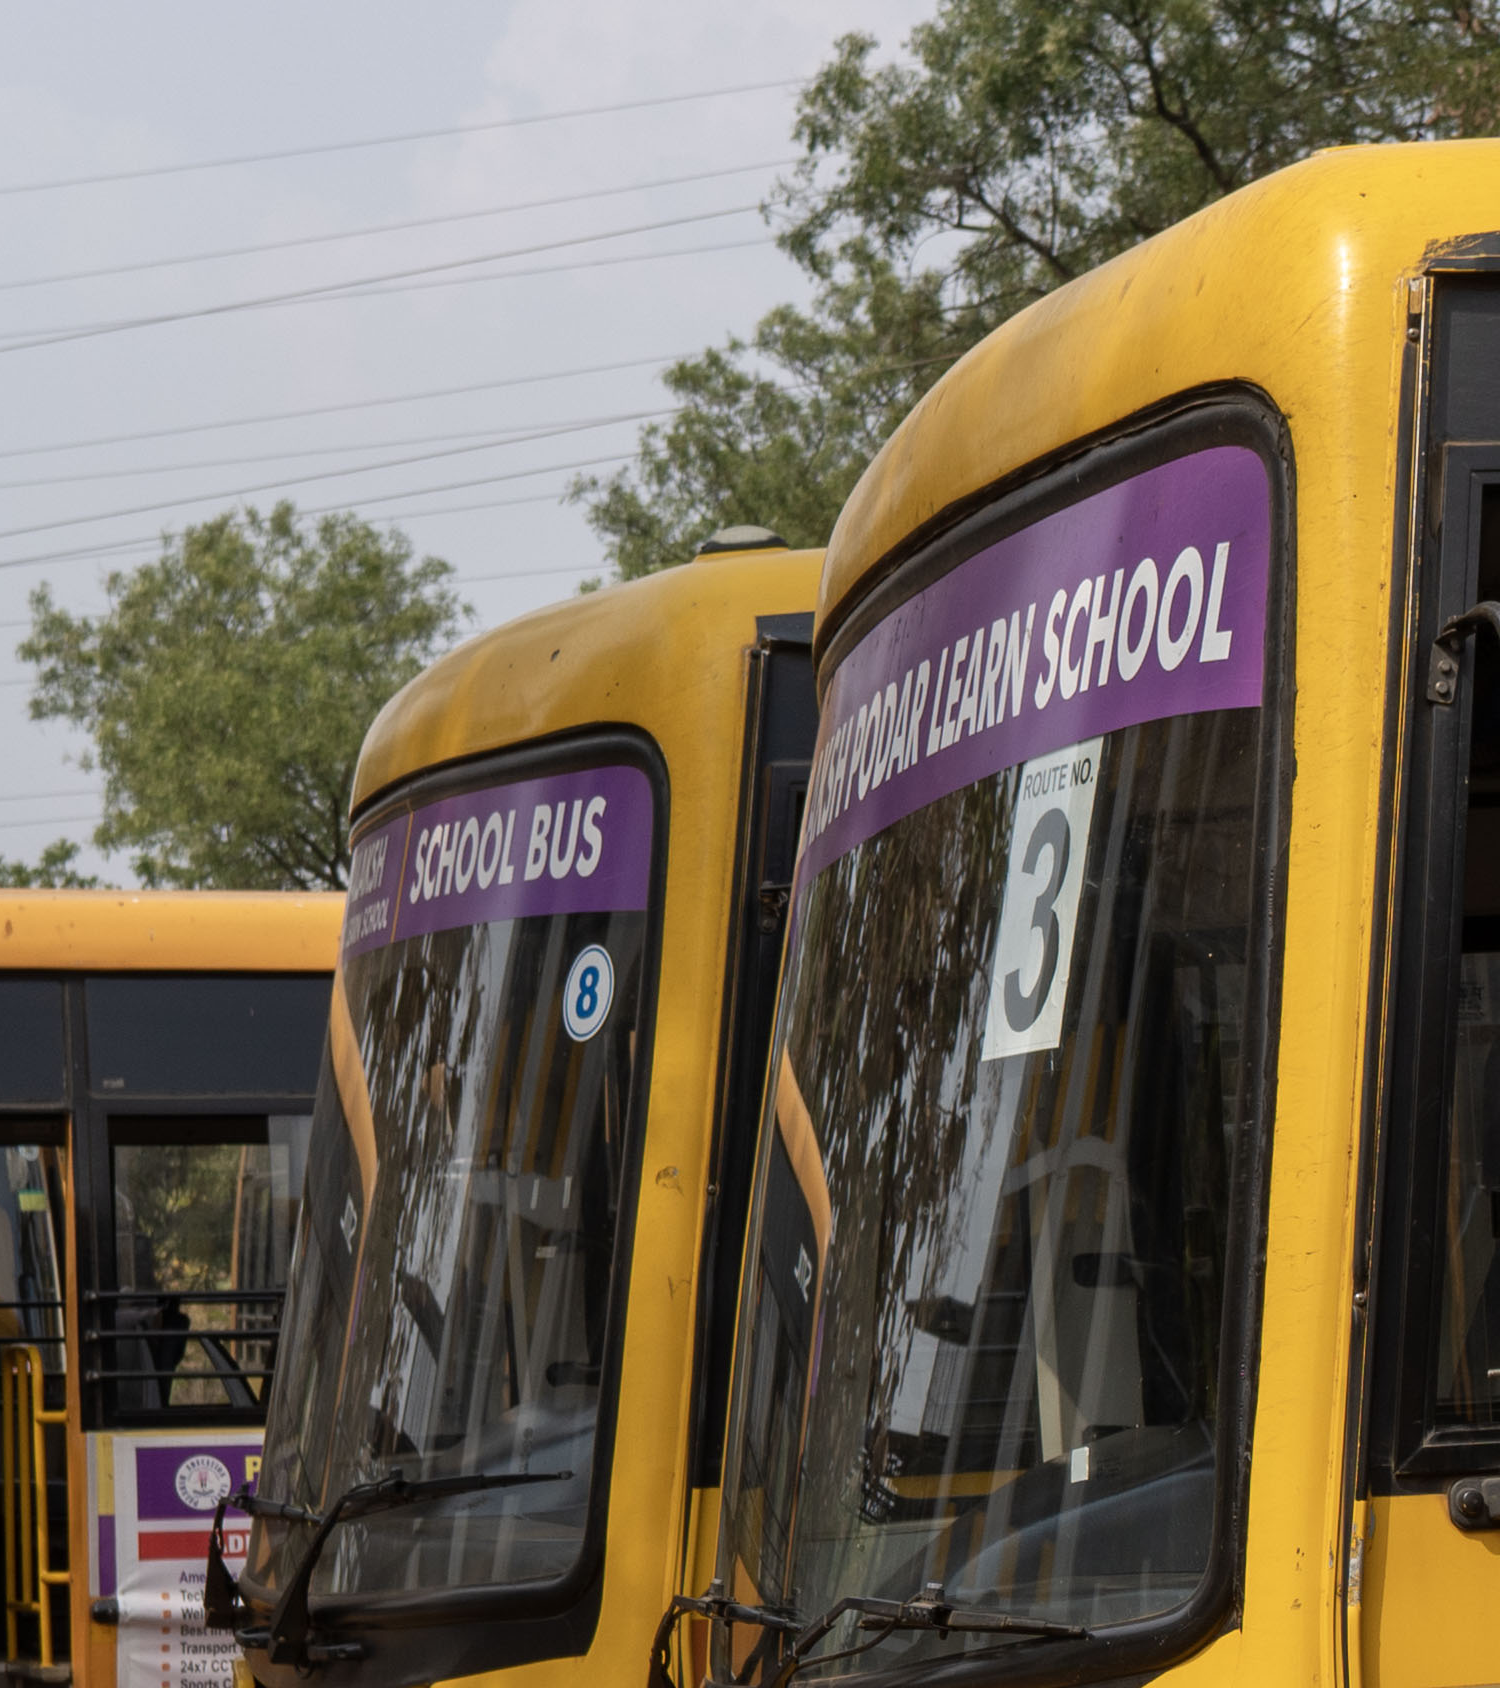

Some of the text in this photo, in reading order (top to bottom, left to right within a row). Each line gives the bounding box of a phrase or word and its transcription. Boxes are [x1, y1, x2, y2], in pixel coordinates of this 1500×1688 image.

[849, 659, 931, 800] PODAR
[926, 603, 1036, 758] LEARN
[1035, 542, 1232, 709] SCHOOL
[1024, 757, 1093, 798] ROUTE NO.
[409, 796, 607, 904] SCHOOL BUS
[1004, 809, 1070, 1033] 3
[575, 965, 599, 1020] 8
[181, 1642, 237, 1657] Transport
[181, 1660, 207, 1673] 24x7
